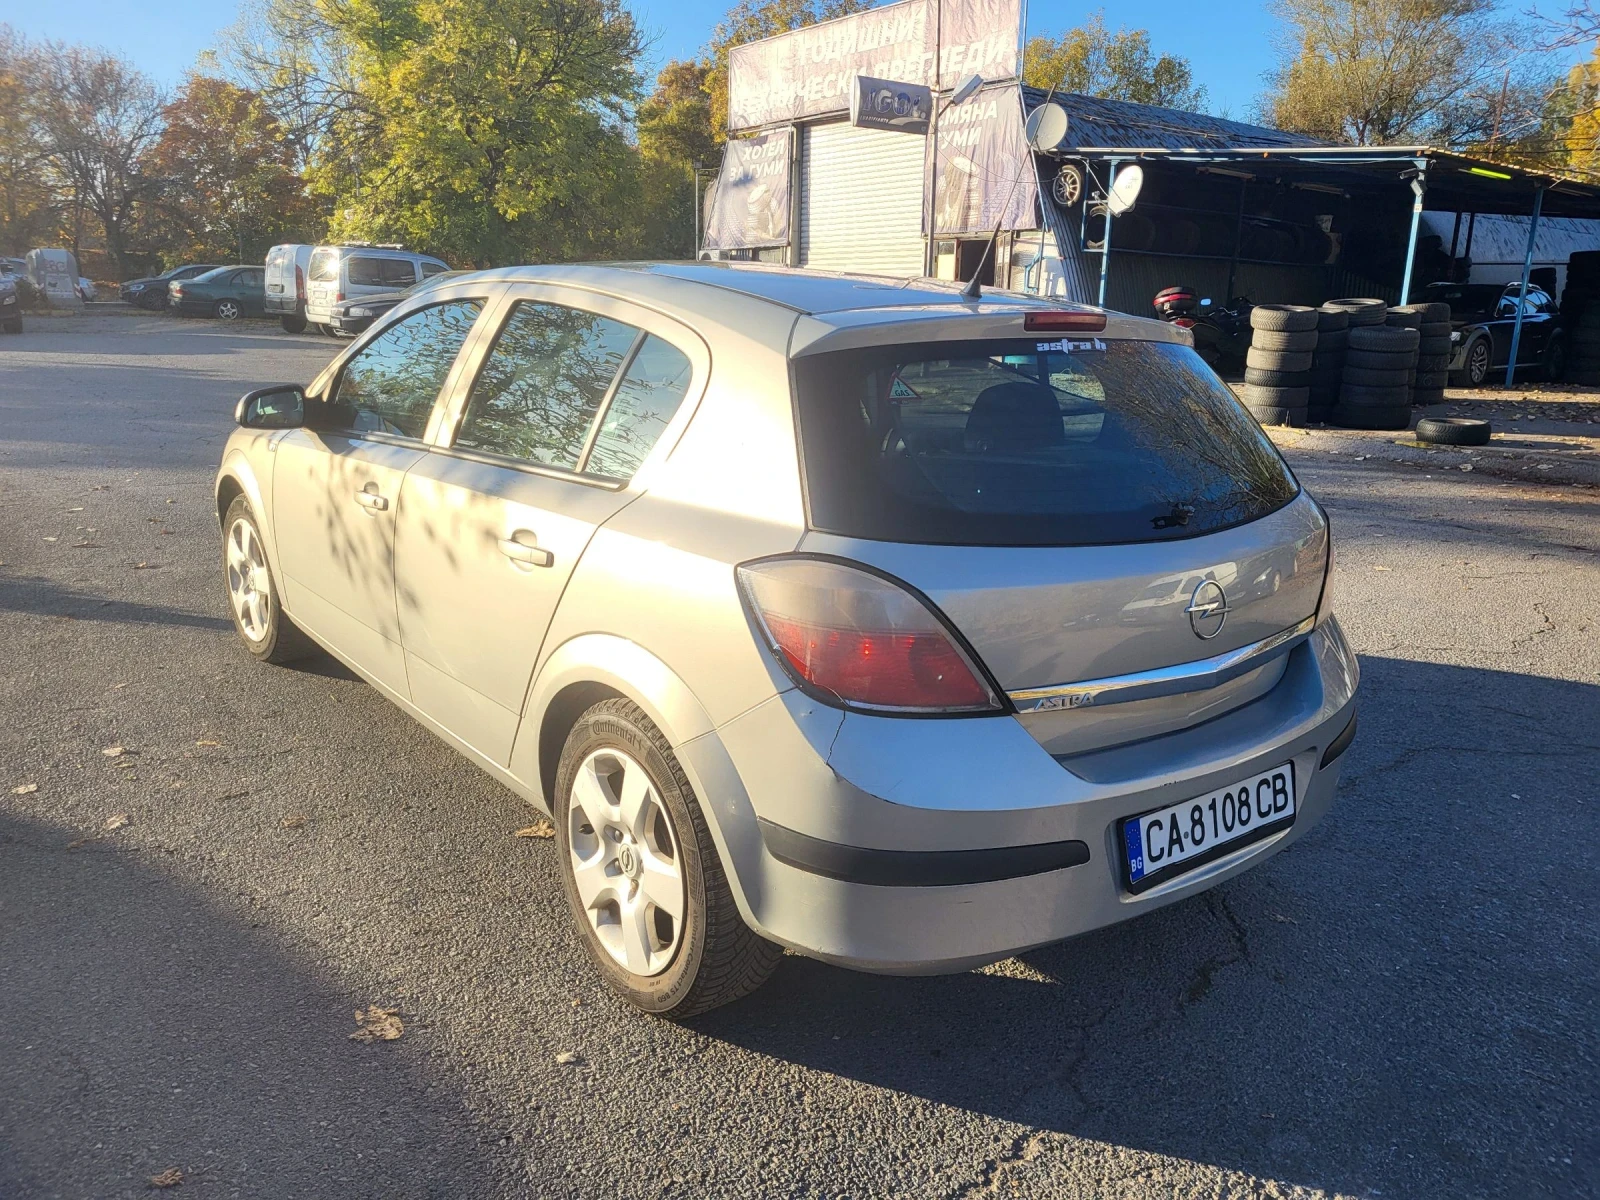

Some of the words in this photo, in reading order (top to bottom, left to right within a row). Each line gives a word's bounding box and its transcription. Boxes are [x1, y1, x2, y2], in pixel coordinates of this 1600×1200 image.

[939, 100, 997, 126] МЯНА
[938, 127, 982, 149] УМИ
[743, 138, 784, 160] ХОТЕЛ
[748, 159, 784, 179] ГУМИ
[1034, 692, 1094, 710] ASTRA
[1131, 856, 1142, 873] BG
